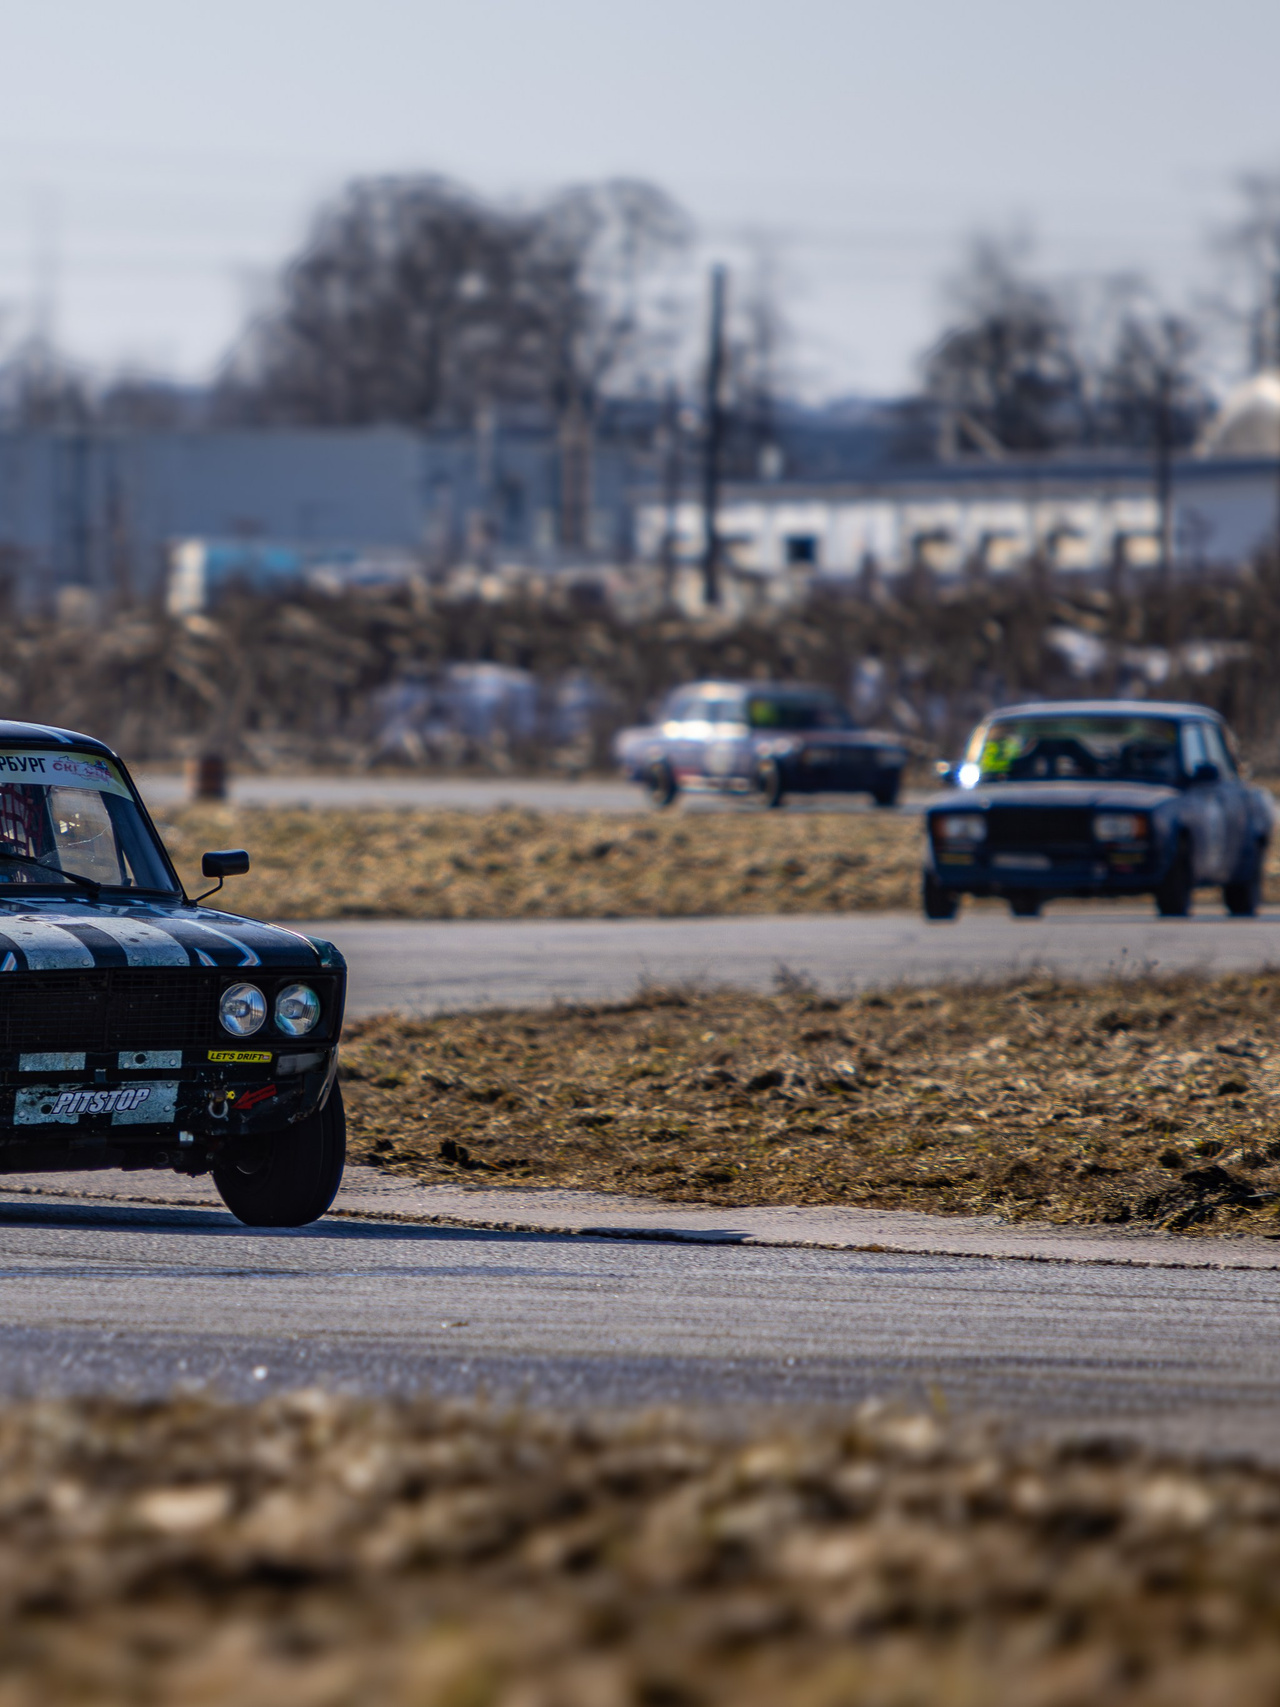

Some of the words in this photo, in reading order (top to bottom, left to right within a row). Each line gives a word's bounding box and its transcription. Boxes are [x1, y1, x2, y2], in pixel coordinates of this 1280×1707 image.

[210, 1052, 236, 1060] LET'S
[236, 1053, 263, 1061] DRIFT
[51, 1088, 151, 1115] PITSTOP
